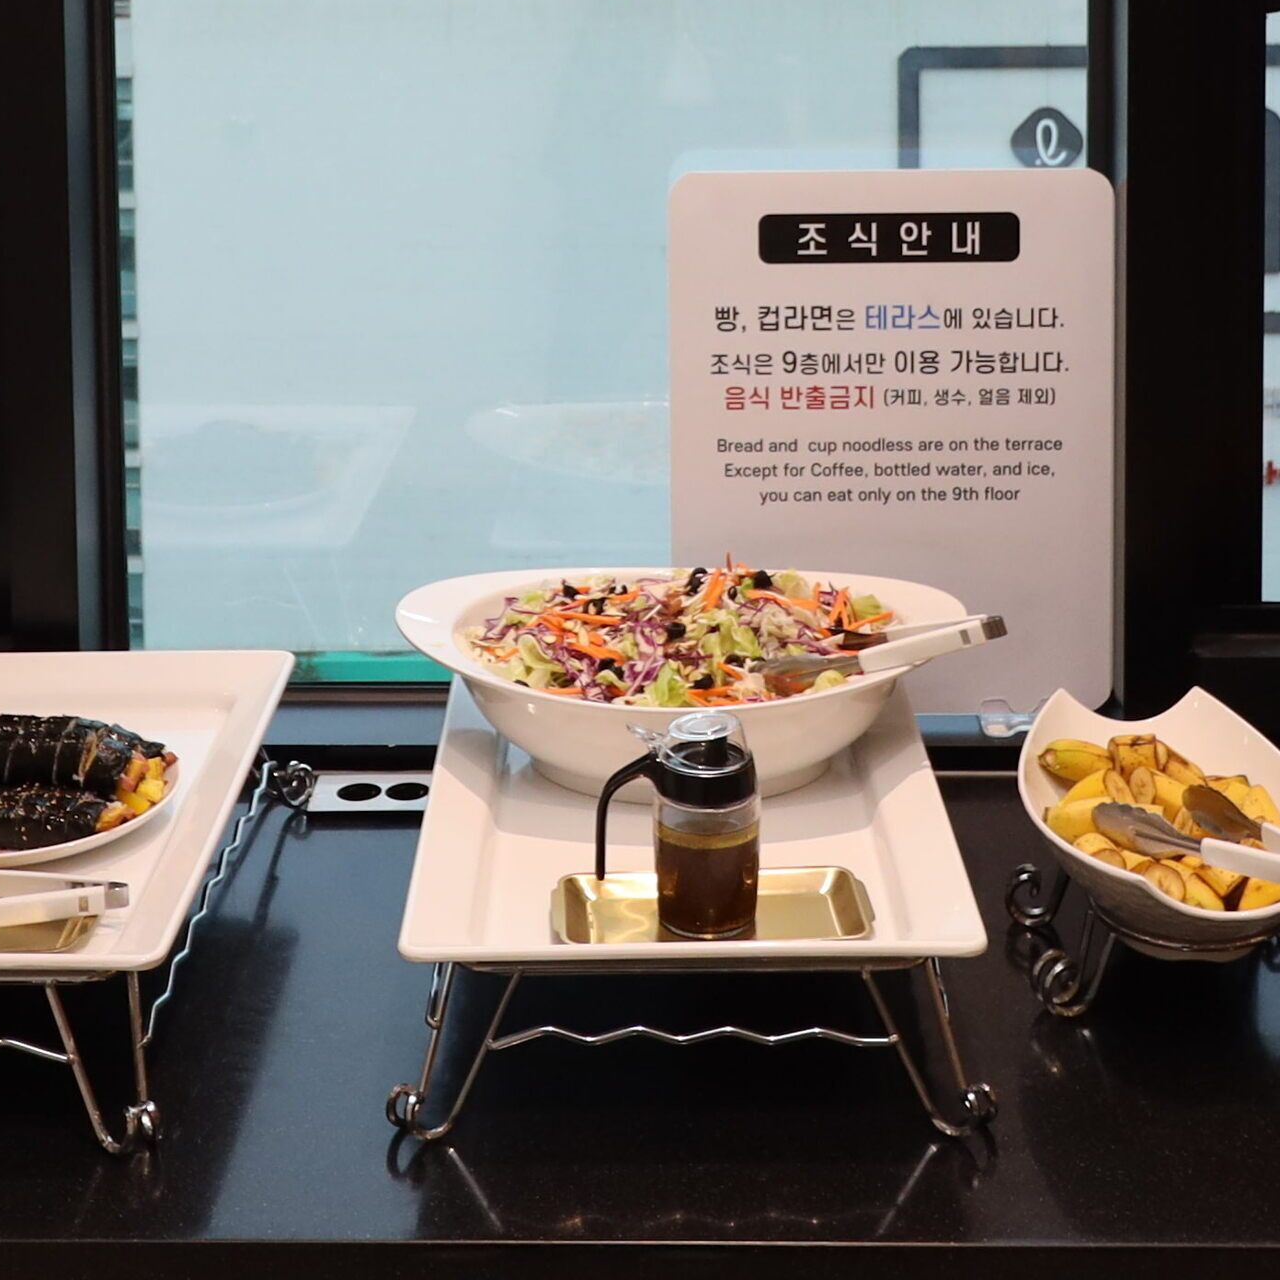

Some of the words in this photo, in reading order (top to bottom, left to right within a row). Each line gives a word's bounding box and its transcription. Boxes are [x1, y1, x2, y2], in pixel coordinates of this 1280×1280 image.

[715, 307, 746, 332] 빵,
[758, 306, 855, 331] 컵라면은
[866, 305, 962, 329] 테라스에
[973, 308, 1064, 329] 있습니다.
[711, 354, 773, 375] 조식은
[782, 351, 886, 375] 9층에서만
[895, 351, 939, 374] 이용
[951, 350, 1068, 374] 가능합니다.
[726, 387, 769, 410] 음식
[781, 386, 873, 409] 반출금지
[884, 389, 927, 406] (커피,
[934, 389, 971, 406] 생수,
[979, 388, 1010, 405] 얼음
[1018, 388, 1055, 405] 제외)
[717, 439, 763, 452] Bread
[769, 439, 797, 452] and
[808, 442, 837, 455] cup
[843, 438, 913, 452] noodless
[918, 441, 943, 451] are
[949, 441, 968, 451] on
[974, 437, 999, 451] the
[1005, 438, 1062, 451] terrace
[725, 463, 778, 480] Except
[784, 463, 805, 477] for
[811, 463, 868, 477] Coffee,
[874, 463, 930, 476] bottled
[936, 463, 986, 477] water,
[993, 462, 1022, 476] and
[1027, 462, 1054, 476] ice,
[760, 492, 788, 505] you
[793, 491, 822, 502] can
[828, 489, 852, 501] eat
[858, 488, 891, 505] only
[896, 491, 915, 501] on
[921, 487, 947, 501] the
[953, 487, 979, 500] 9th
[985, 487, 1020, 500] floor
